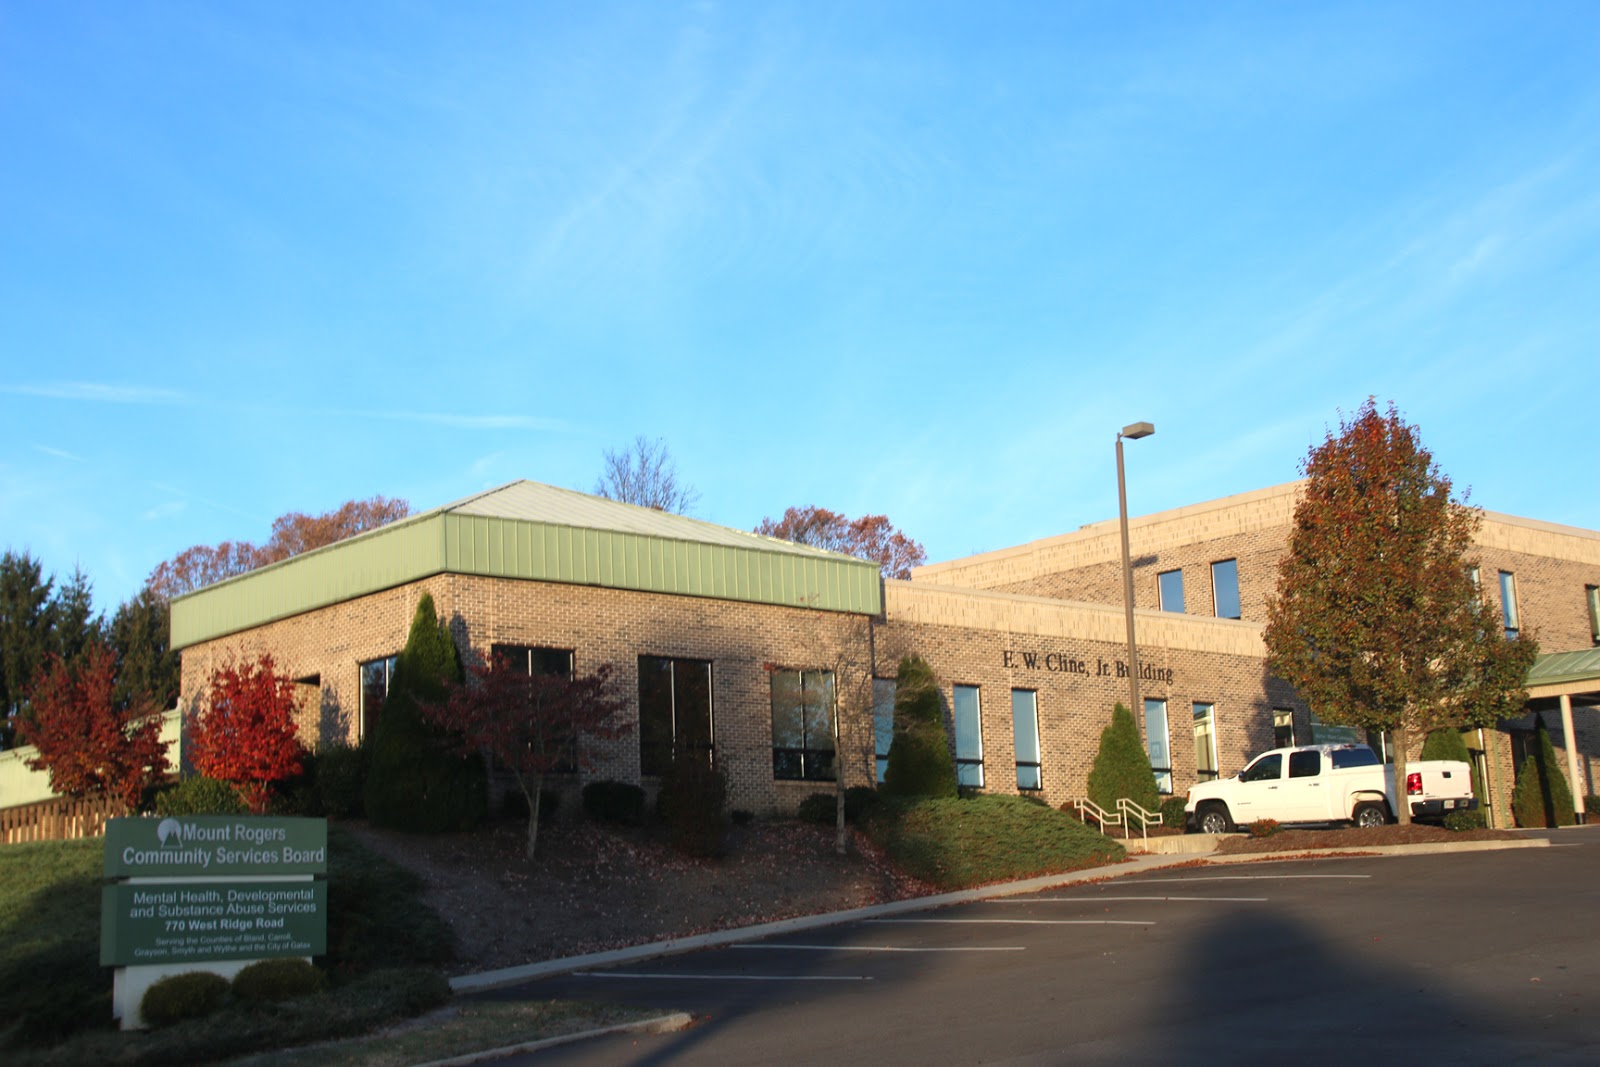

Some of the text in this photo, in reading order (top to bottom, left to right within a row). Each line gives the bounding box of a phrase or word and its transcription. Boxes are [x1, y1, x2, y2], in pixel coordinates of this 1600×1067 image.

[1003, 650, 1018, 669] E.
[1023, 652, 1041, 671] W.
[1046, 653, 1089, 678] Cline,
[1096, 659, 1111, 676] Jr.
[183, 823, 287, 845] Mount Rogers
[122, 846, 325, 868] Community Services Board
[133, 888, 314, 905] Mental Health, Developmental
[130, 900, 317, 918] and Substance Abuse Services
[165, 917, 285, 932] 770 West Ridge Road
[155, 932, 293, 947] Serving the Counties of Bland, Carroll,
[134, 940, 311, 958] Grayson, Smyth and Wythe and the City of Galax
